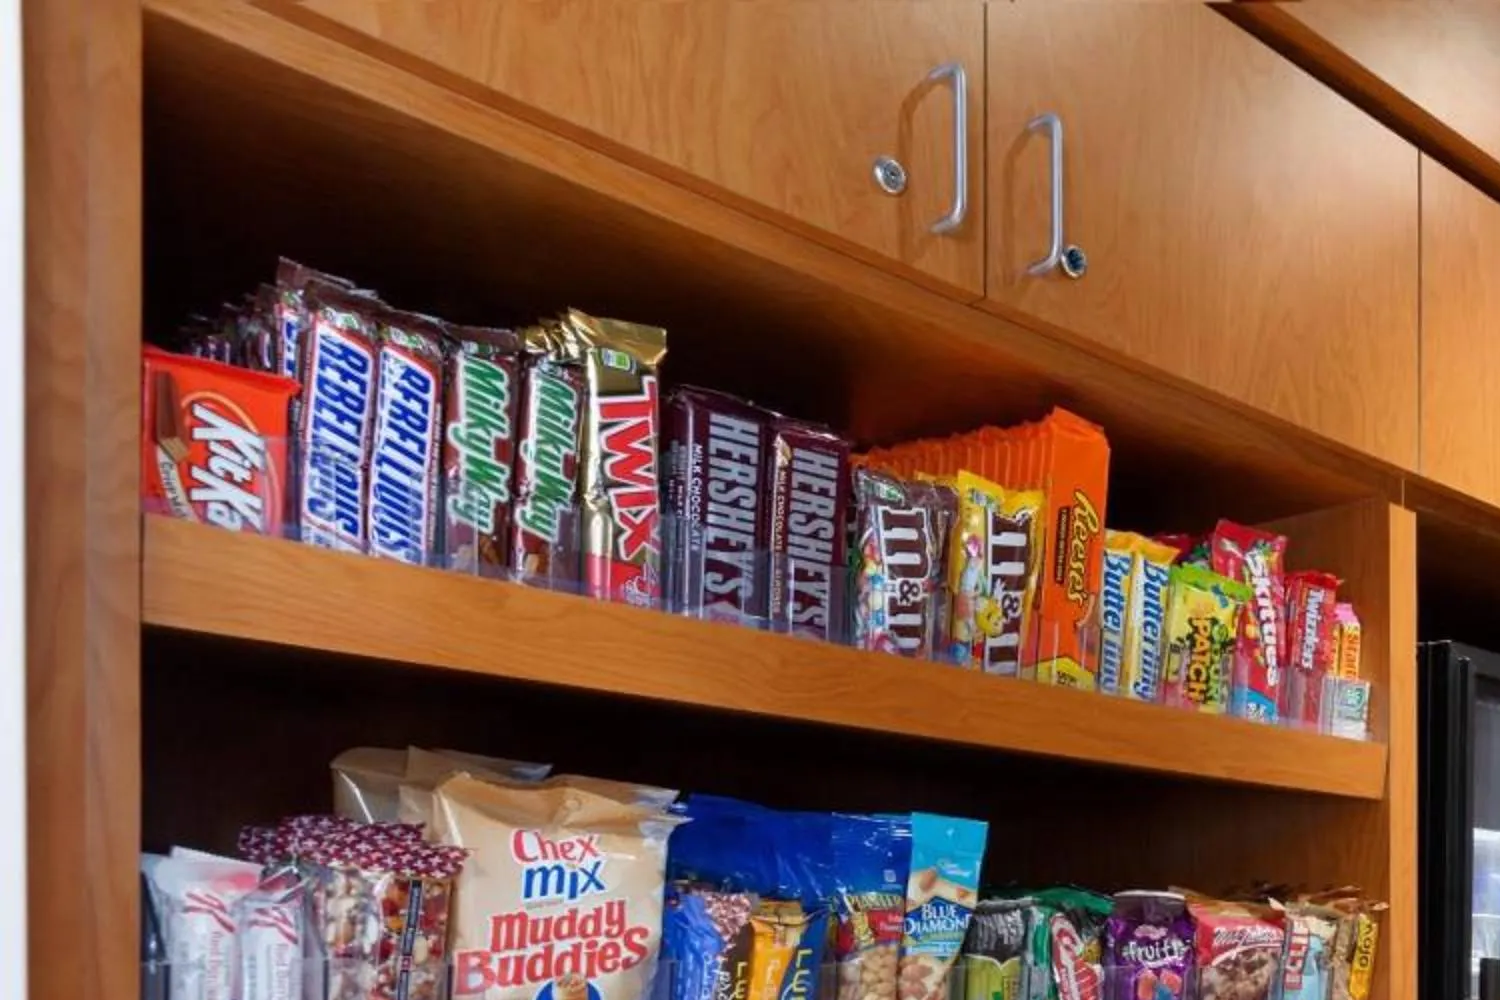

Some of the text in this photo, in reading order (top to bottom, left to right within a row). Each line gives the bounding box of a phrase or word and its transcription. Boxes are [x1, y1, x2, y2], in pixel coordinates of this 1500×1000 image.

[191, 403, 266, 531] Kit Ka
[600, 375, 657, 559] TWIX
[704, 413, 760, 596] HERSHEY'S
[787, 448, 839, 627] HERSHEY'S
[1068, 491, 1100, 606] Reese's
[1246, 550, 1279, 687] Skittles
[1301, 588, 1324, 670] Twizzlers
[512, 829, 600, 863] Chex
[454, 926, 650, 996] Buddies
[921, 903, 958, 919] BLUE
